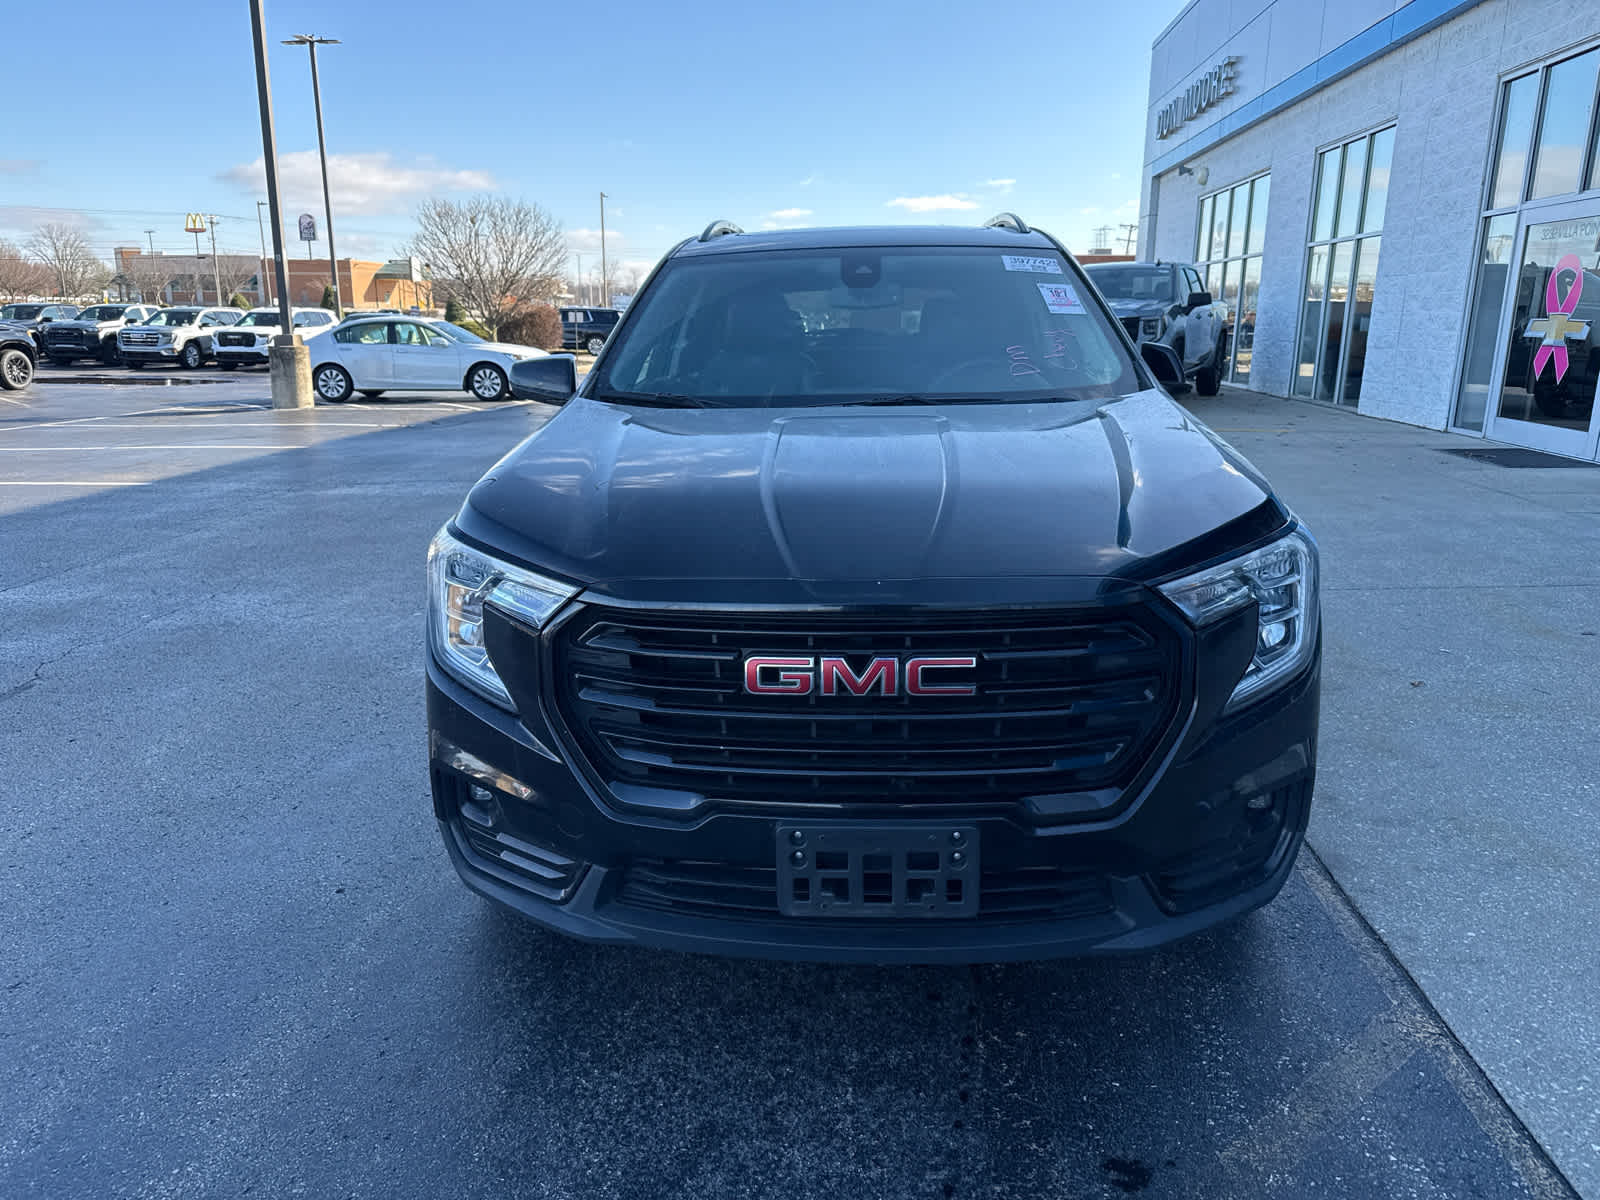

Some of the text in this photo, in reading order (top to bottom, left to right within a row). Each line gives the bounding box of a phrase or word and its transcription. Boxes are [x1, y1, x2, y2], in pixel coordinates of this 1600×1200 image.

[1156, 56, 1245, 140] DON MOORE
[744, 656, 977, 696] GMC
